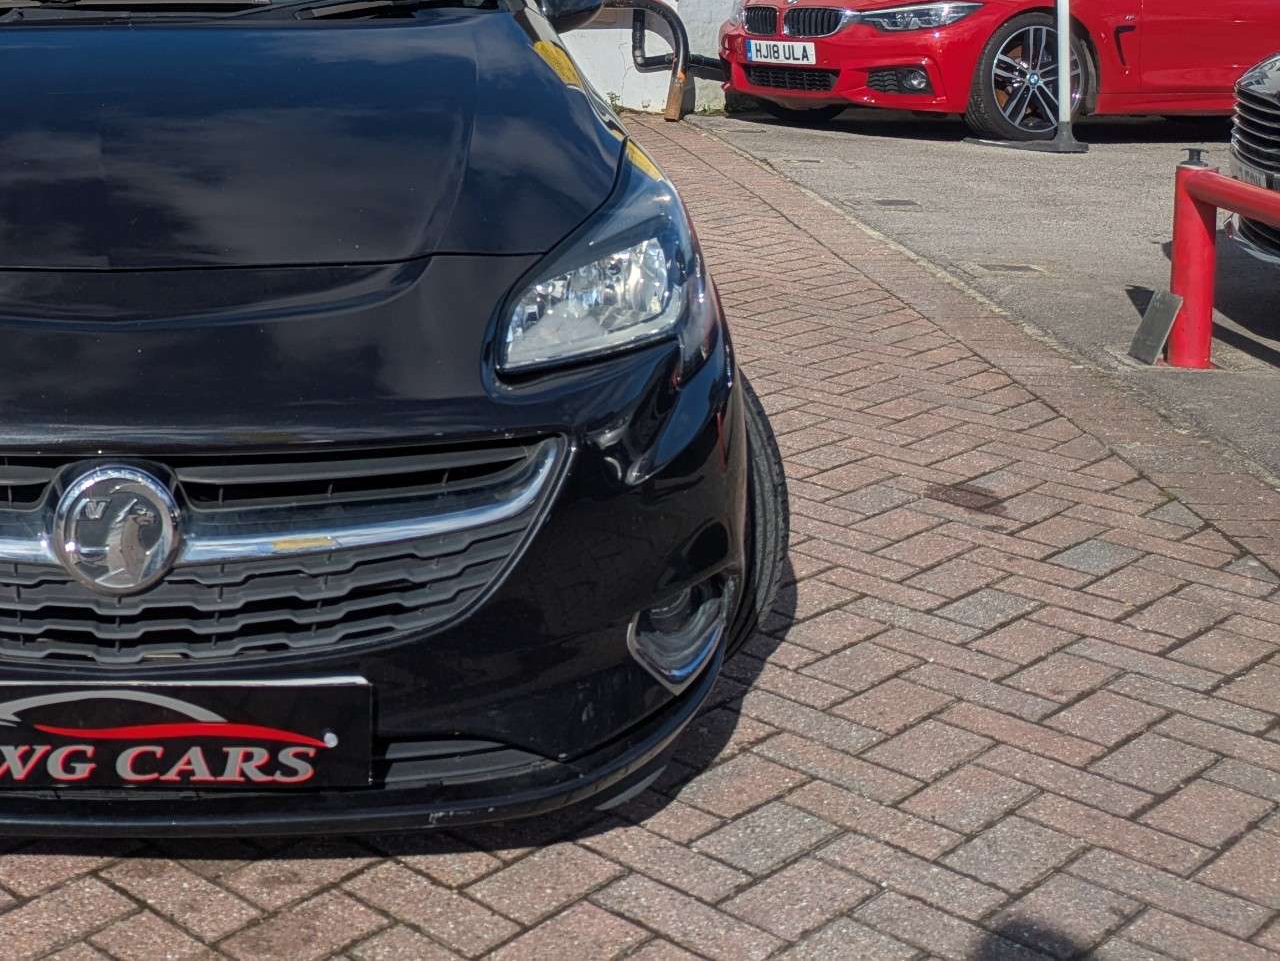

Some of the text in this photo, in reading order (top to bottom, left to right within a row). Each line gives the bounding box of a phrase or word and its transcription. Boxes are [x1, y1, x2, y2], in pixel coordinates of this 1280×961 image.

[754, 42, 810, 62] HJ18 ULA
[115, 745, 317, 784] CARS
